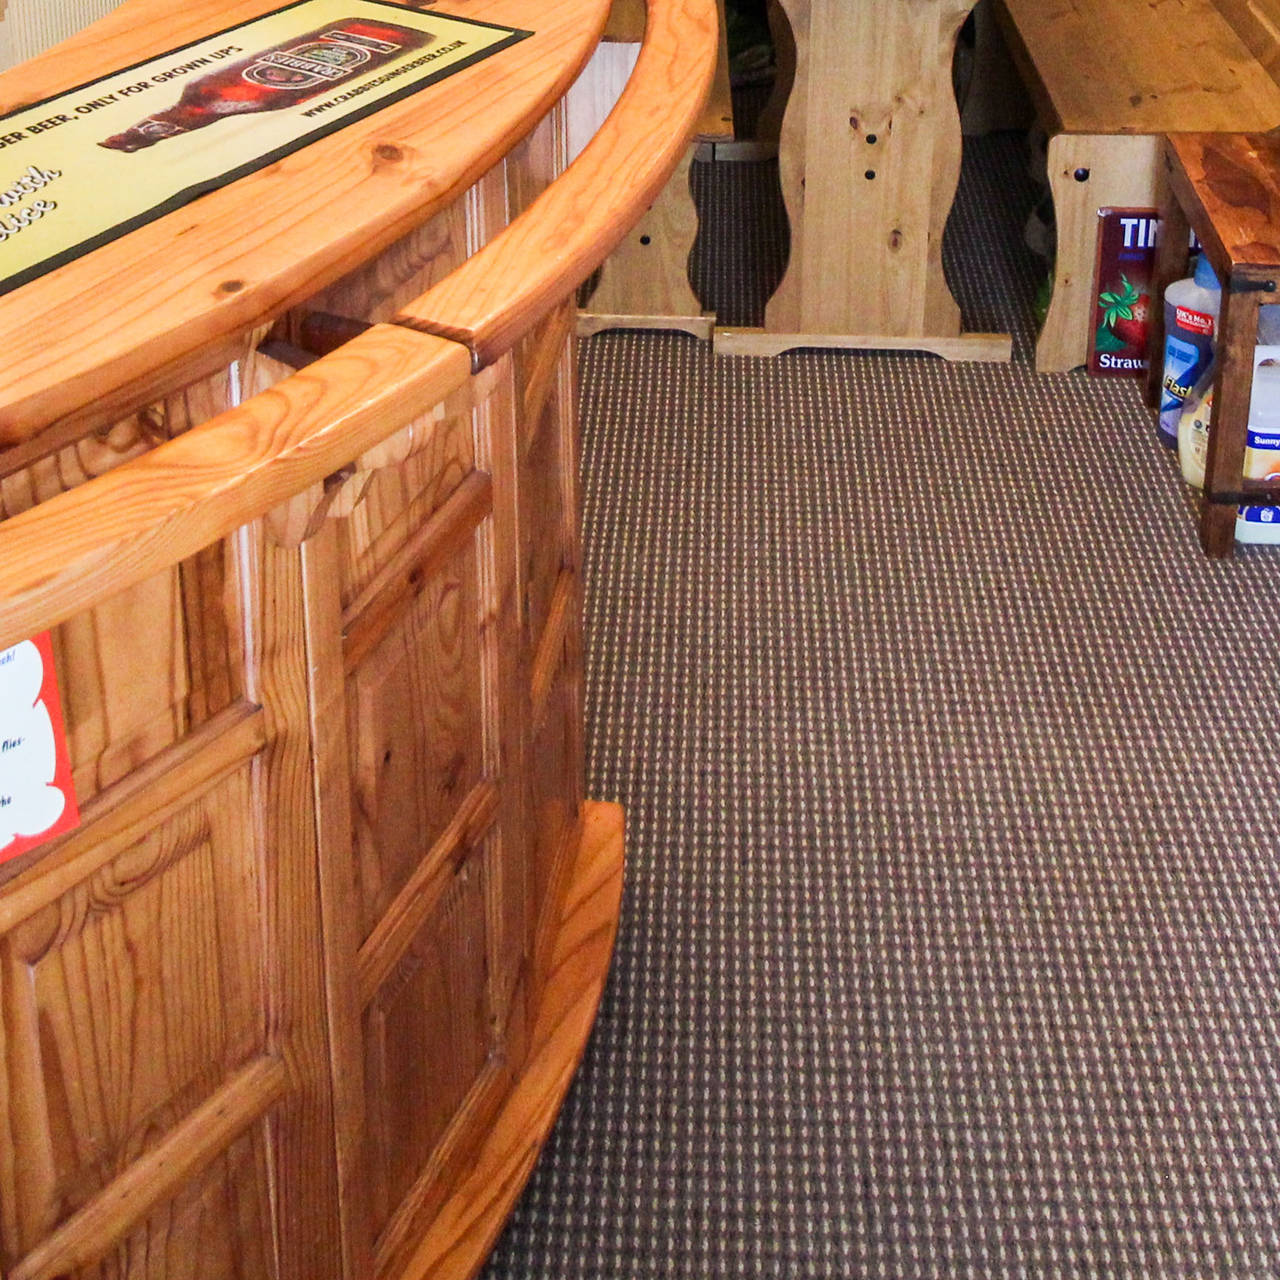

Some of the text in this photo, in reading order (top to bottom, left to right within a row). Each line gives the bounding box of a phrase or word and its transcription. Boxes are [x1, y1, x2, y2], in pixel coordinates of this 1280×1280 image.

[25, 112, 79, 134] BEER,
[74, 93, 120, 115] ONLY
[118, 80, 154, 97] FOR
[151, 56, 210, 84] GROWN
[209, 45, 244, 61] UPS
